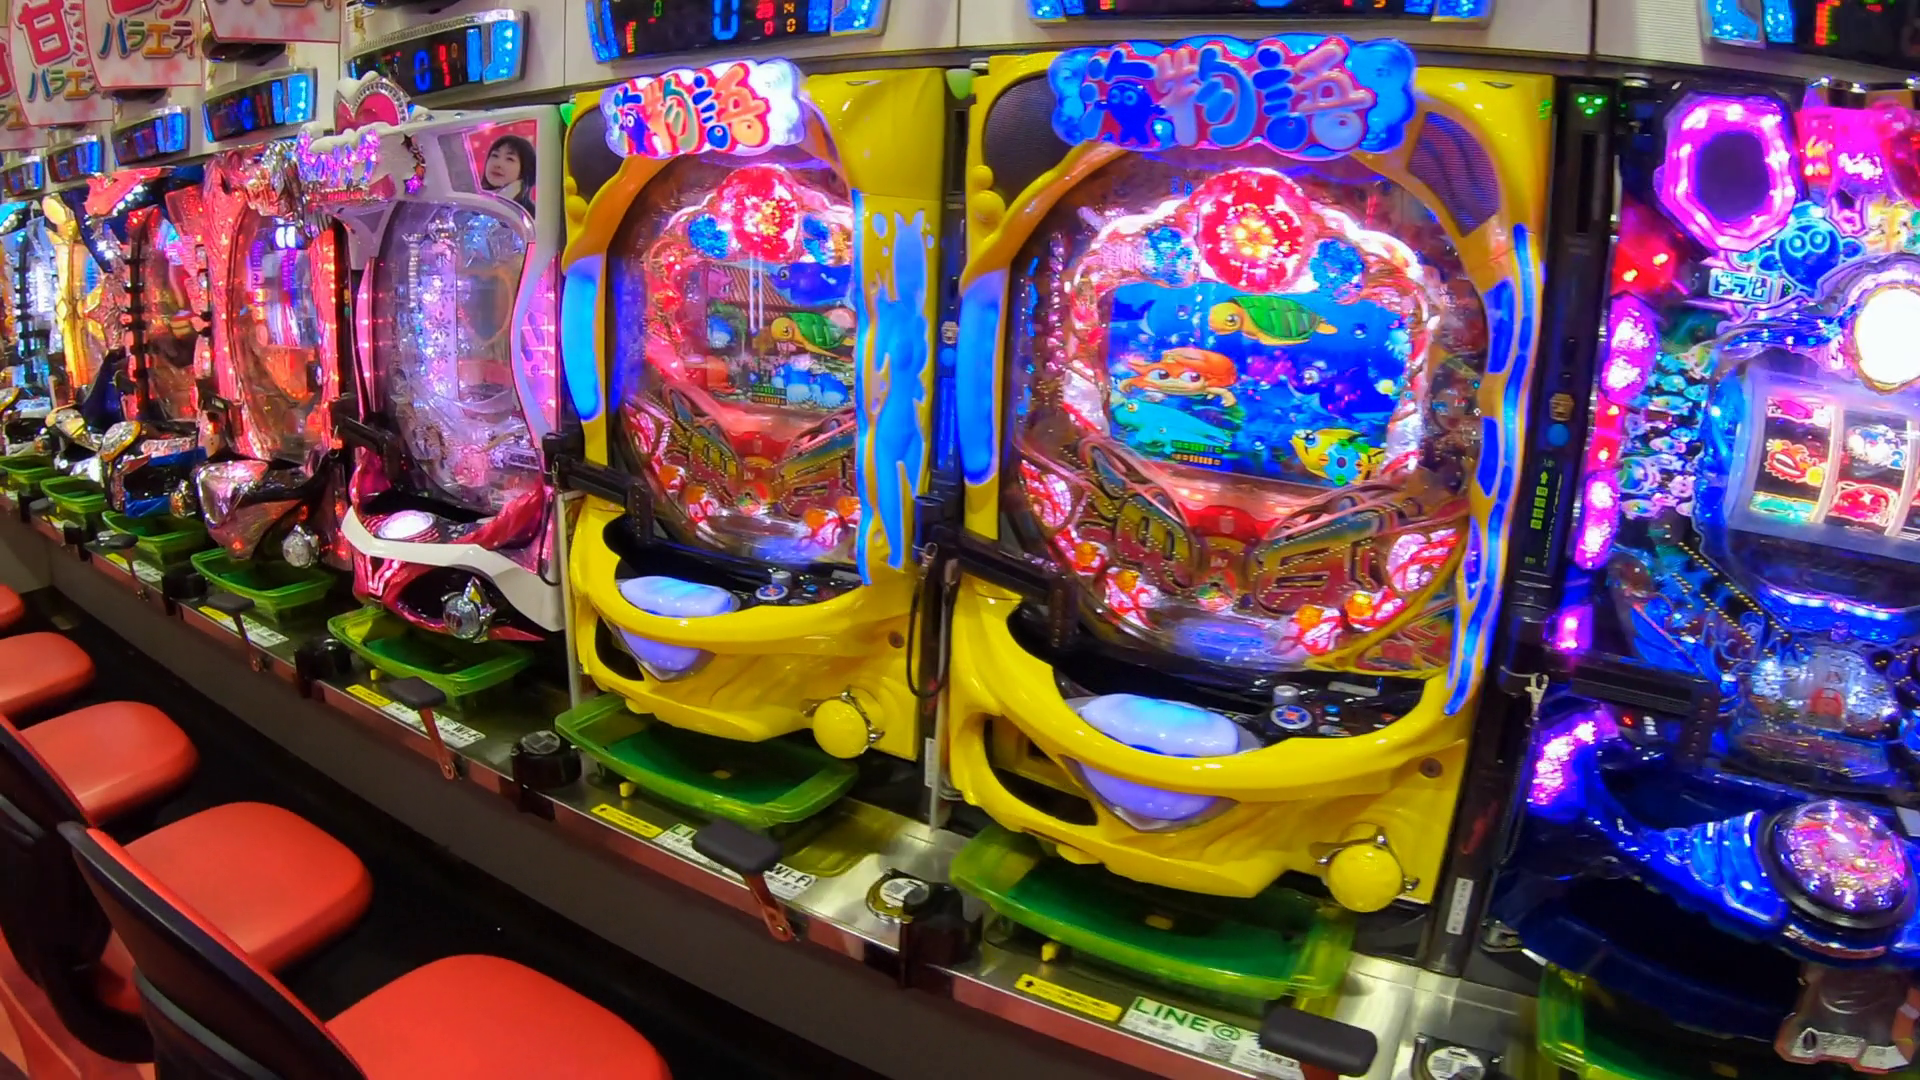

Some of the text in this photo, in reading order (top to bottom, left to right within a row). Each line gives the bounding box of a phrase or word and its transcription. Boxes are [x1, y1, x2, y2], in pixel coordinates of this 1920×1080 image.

[98, 18, 197, 59] バラエティ
[1134, 998, 1241, 1042] LINE@
